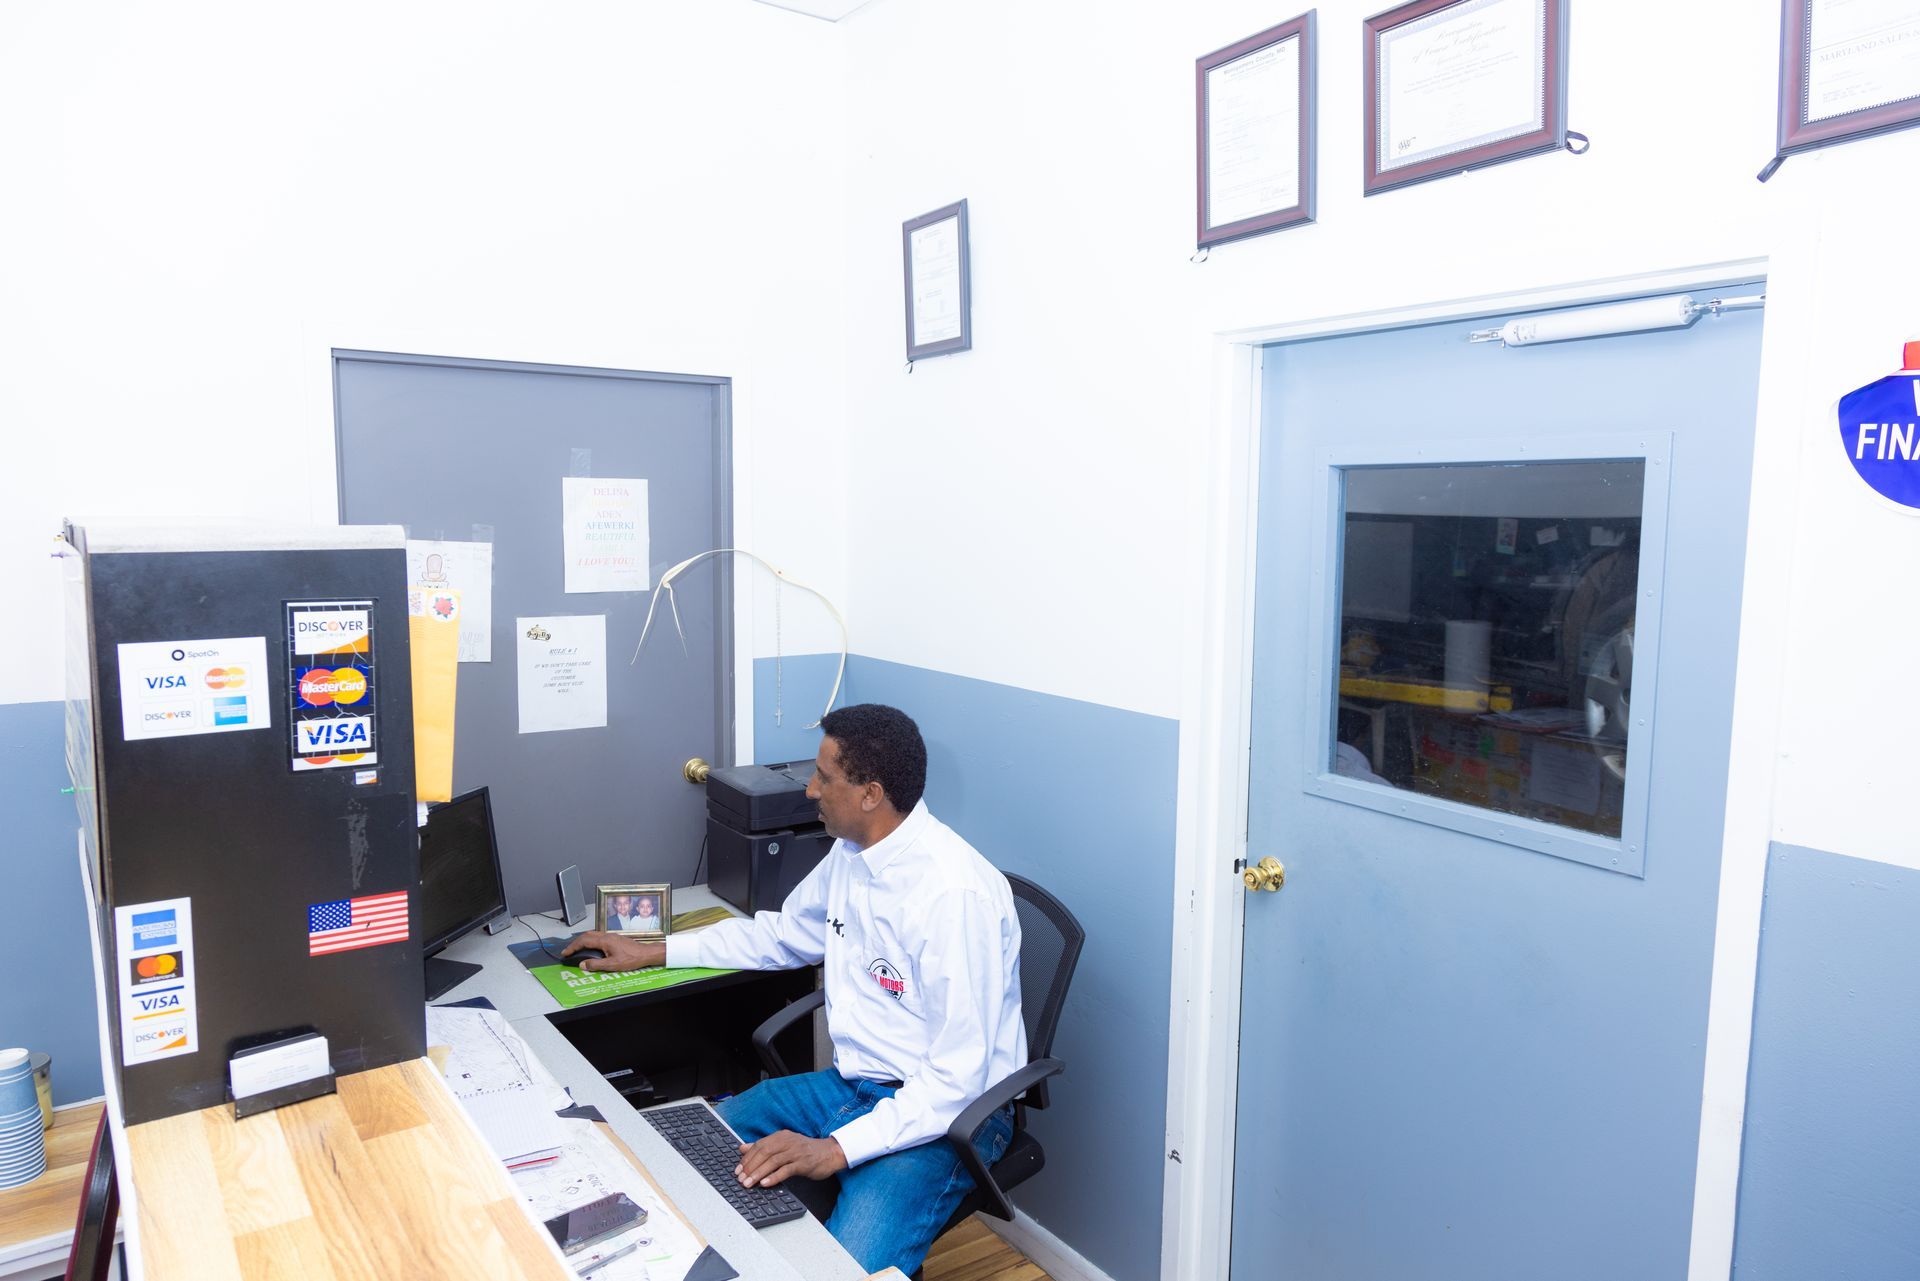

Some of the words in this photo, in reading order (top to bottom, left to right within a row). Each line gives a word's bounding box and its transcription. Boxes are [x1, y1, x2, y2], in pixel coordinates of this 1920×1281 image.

[1819, 41, 1877, 62] MARYLAND
[1878, 31, 1911, 45] SALES
[585, 521, 635, 530] AFEWERKI
[298, 620, 363, 632] DISCOVER
[187, 649, 219, 658] SpotOn
[144, 675, 187, 690] VISA
[301, 679, 365, 694] MasterCard
[144, 709, 192, 722] DISCOVER
[303, 722, 367, 746] VISA
[560, 970, 577, 980] A
[879, 976, 905, 992] MOTORS
[141, 995, 179, 1010] VISA
[135, 1027, 185, 1042] DISCOVER
